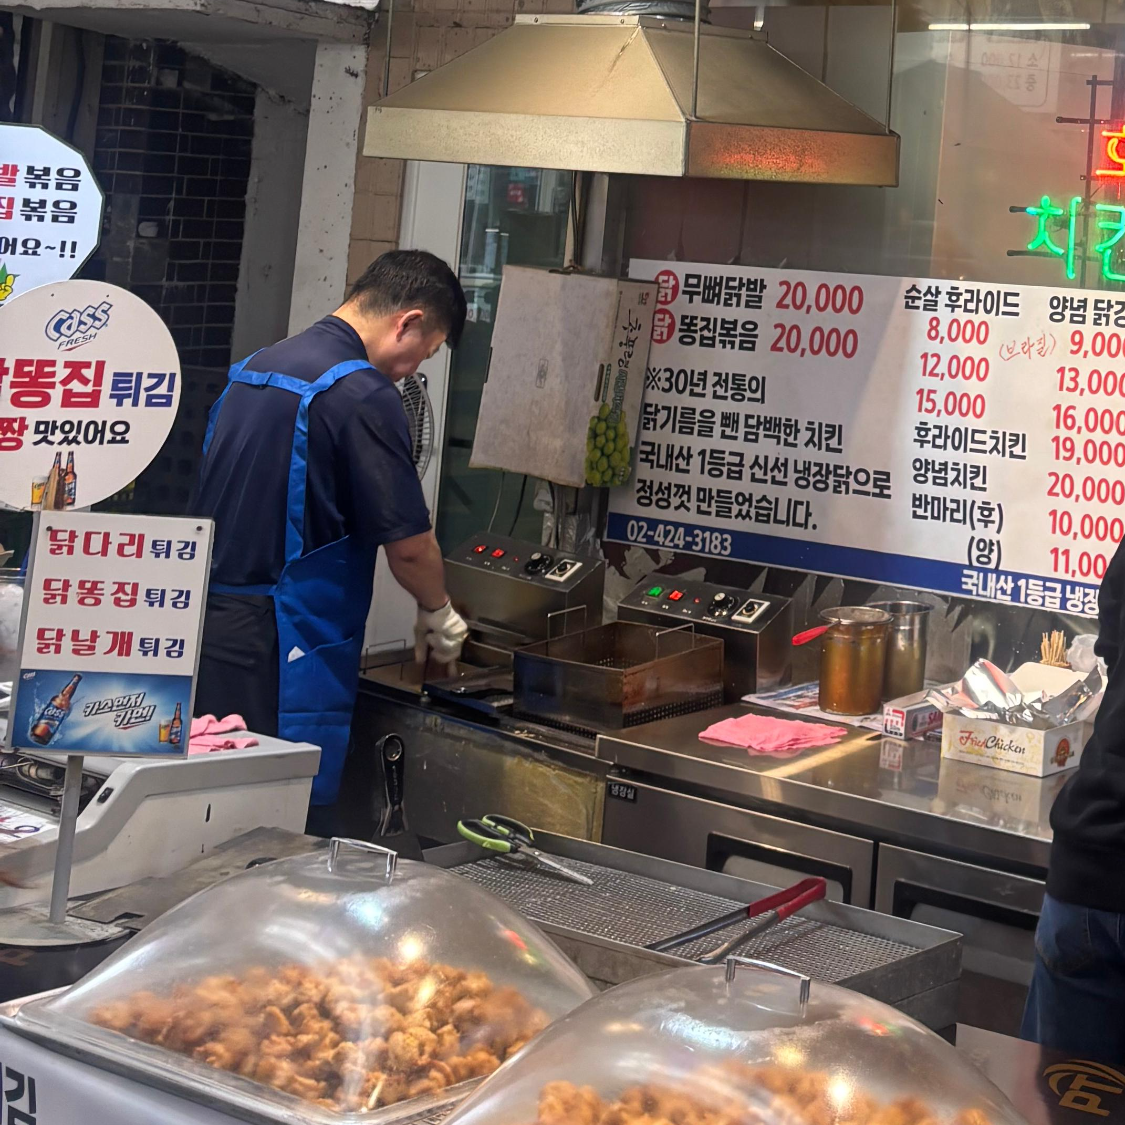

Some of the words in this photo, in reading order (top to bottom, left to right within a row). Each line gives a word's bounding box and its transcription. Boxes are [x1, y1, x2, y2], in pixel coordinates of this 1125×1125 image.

[24, 165, 82, 192] 볶음
[20, 197, 78, 224] 볶음
[681, 273, 767, 310] 무뼈닭발
[775, 280, 864, 315] 20,000
[903, 283, 942, 313] 순살
[944, 285, 1021, 317] 후라이드
[1049, 295, 1088, 326] 양념
[57, 332, 98, 350] FRESH
[678, 314, 759, 352] 똥집볶음
[769, 322, 859, 359] 20,000
[926, 316, 990, 346] 8,000
[0, 357, 106, 409] 똥집
[108, 371, 177, 408] 튀김
[920, 351, 990, 383] 12,000
[711, 372, 767, 405] 전통의
[915, 387, 986, 419] 15,000
[32, 419, 131, 446] 맛있어요
[642, 401, 716, 439] 닭기름을
[720, 410, 740, 441] 뺀
[743, 413, 801, 449] 담백한
[803, 421, 843, 454] 치킨
[913, 421, 1027, 461] 후라이드치킨
[638, 440, 693, 475] 국내산
[697, 447, 745, 482] 1등급
[748, 454, 789, 487] 신선
[793, 458, 892, 500] 냉장닭으로
[911, 457, 988, 492] 양념치킨
[1046, 471, 1125, 506] 20,000
[636, 478, 692, 513] 정성껏
[696, 486, 818, 531] 만들었습니다.
[911, 493, 1004, 535] 반마리(후)
[1048, 509, 1124, 544] 10,000
[49, 528, 145, 559] 닭다리
[149, 539, 197, 561] 튀김
[626, 519, 732, 556] 02-424-3183
[967, 536, 1002, 570] (양)
[1050, 547, 1107, 579] 11,00
[42, 577, 140, 608] 닭똥집
[143, 588, 191, 610] 튀김
[961, 568, 1015, 601] 국내산
[1017, 578, 1062, 612] 1등급
[36, 627, 134, 658] 닭날개
[137, 636, 185, 659] 튀김
[611, 784, 635, 800] 냉장실
